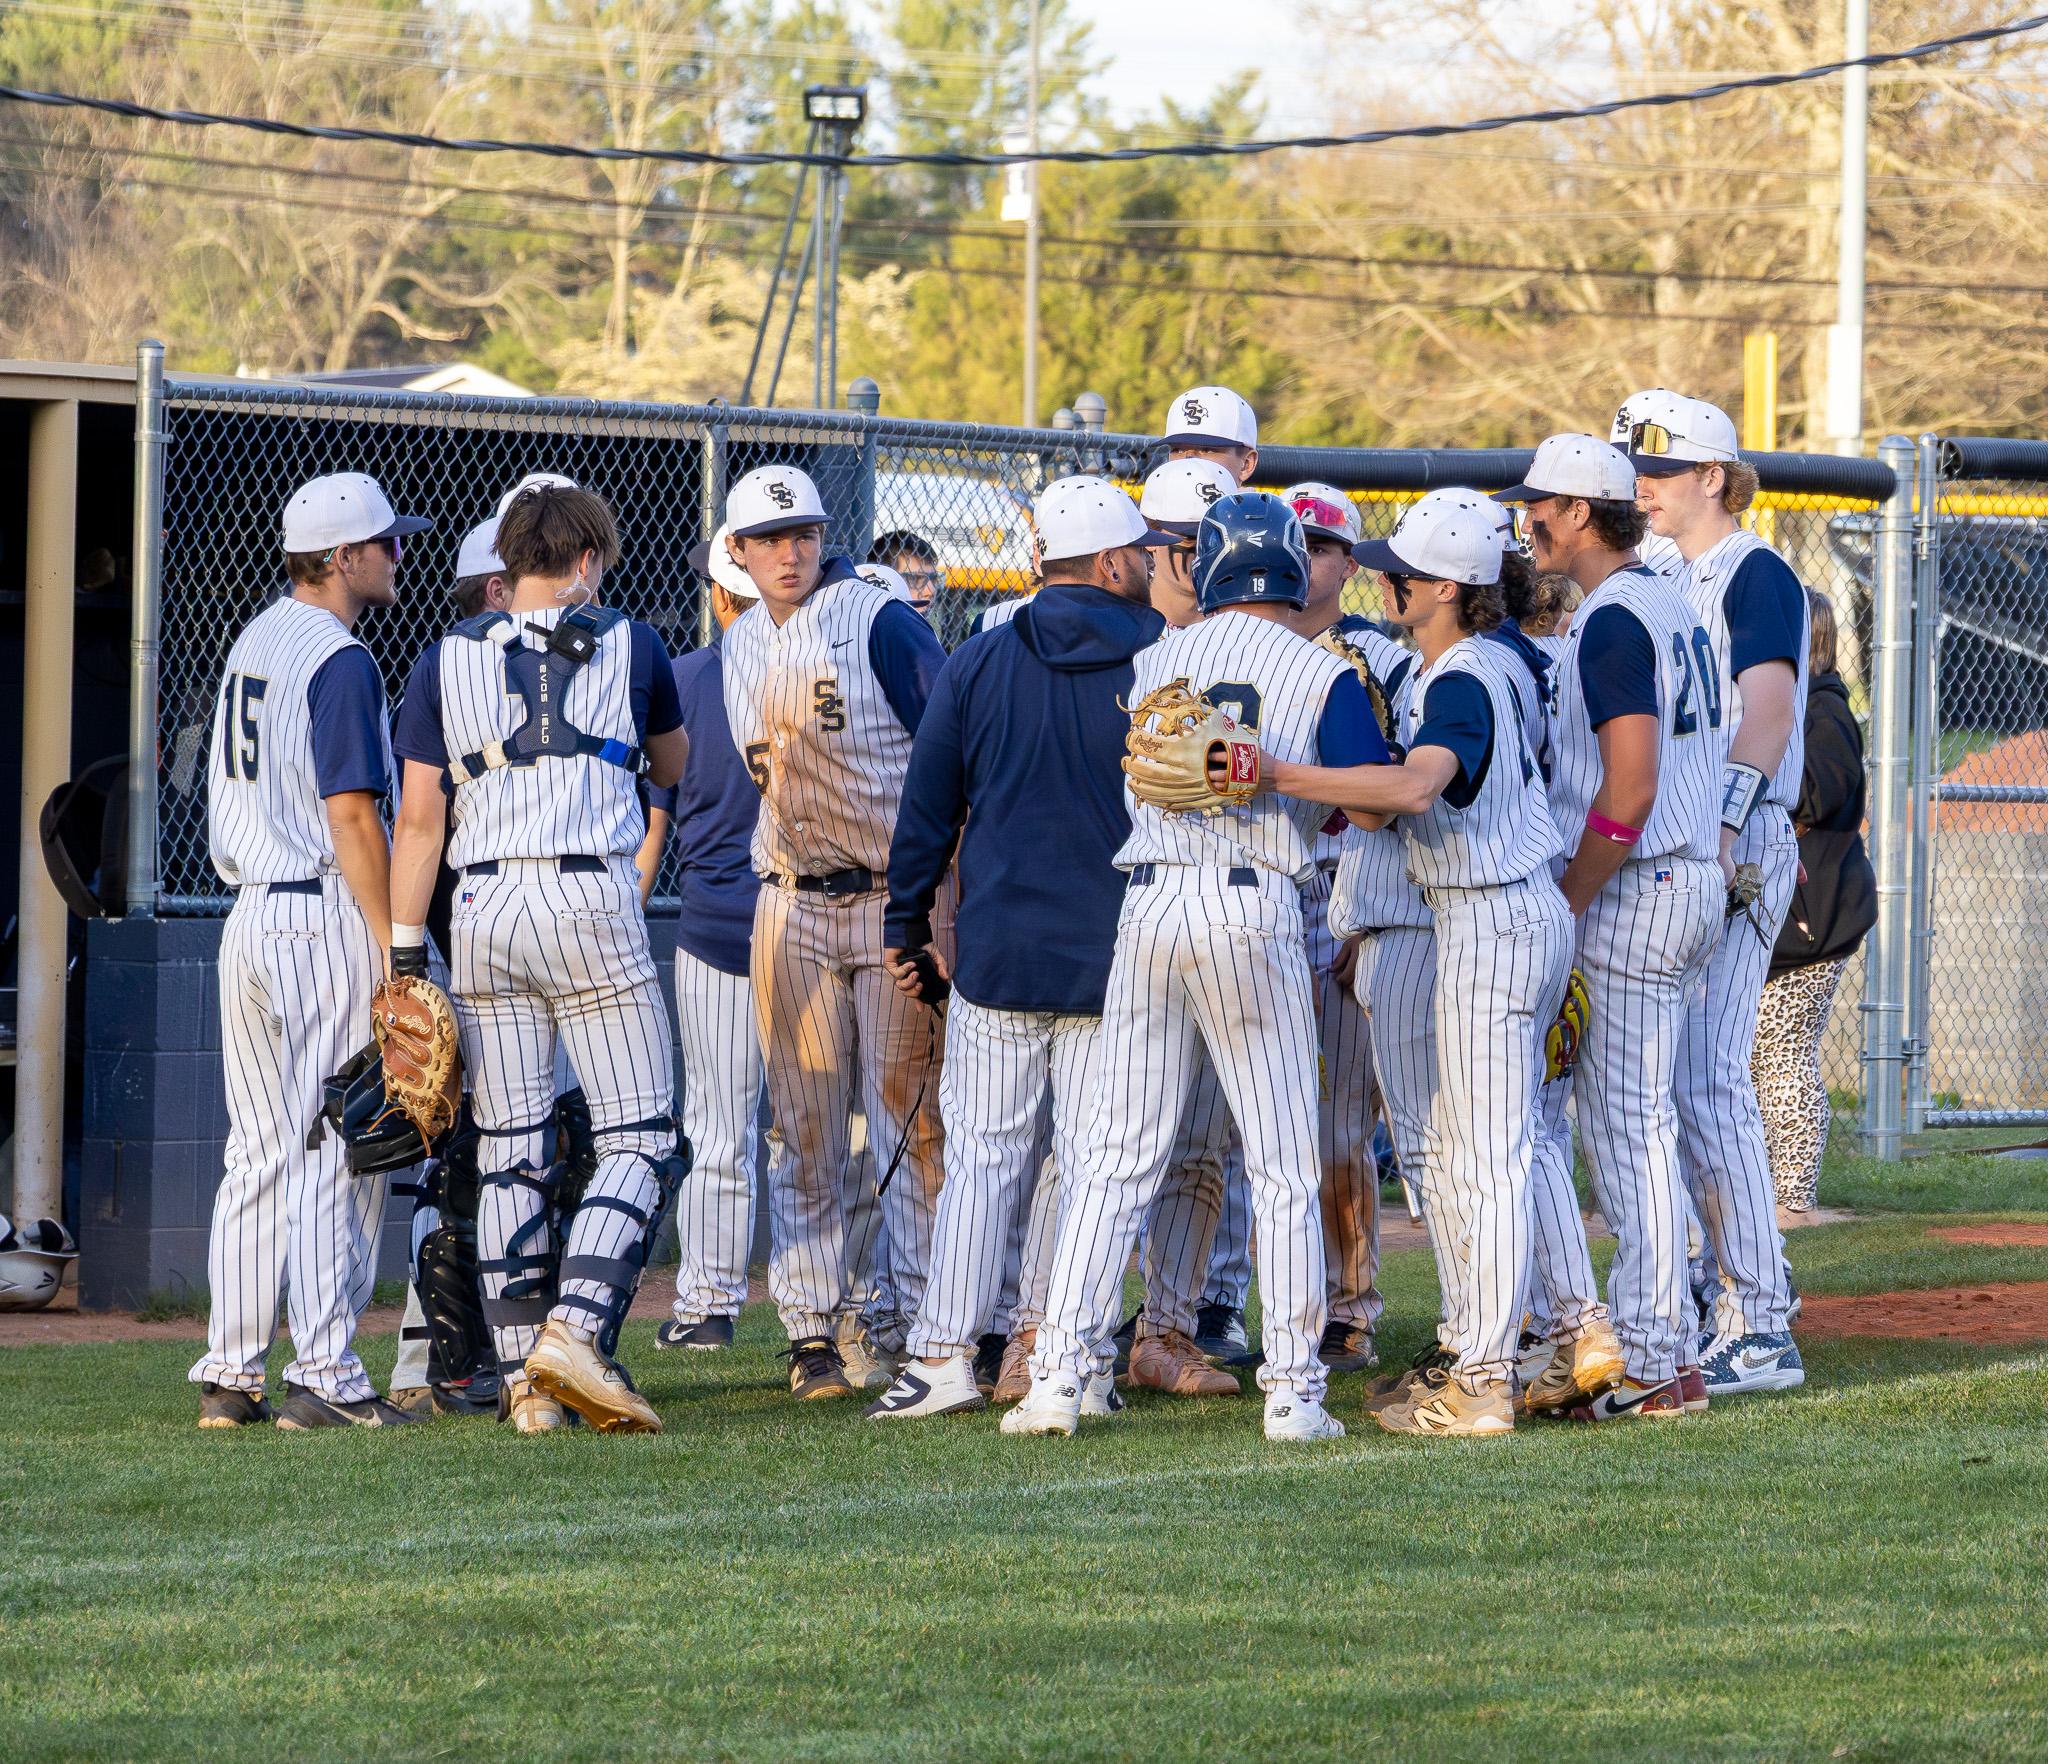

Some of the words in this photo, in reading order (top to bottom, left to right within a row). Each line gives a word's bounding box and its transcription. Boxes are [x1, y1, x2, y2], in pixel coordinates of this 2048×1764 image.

[768, 481, 796, 510] SS
[1252, 577, 1265, 593] 19
[1671, 624, 1721, 739] 20
[813, 678, 847, 734] SS
[224, 670, 270, 784] 15
[1238, 745, 1252, 779] Rawlings
[399, 1014, 431, 1035] Rawlings
[880, 1379, 918, 1409] N
[1413, 1398, 1458, 1430] N
